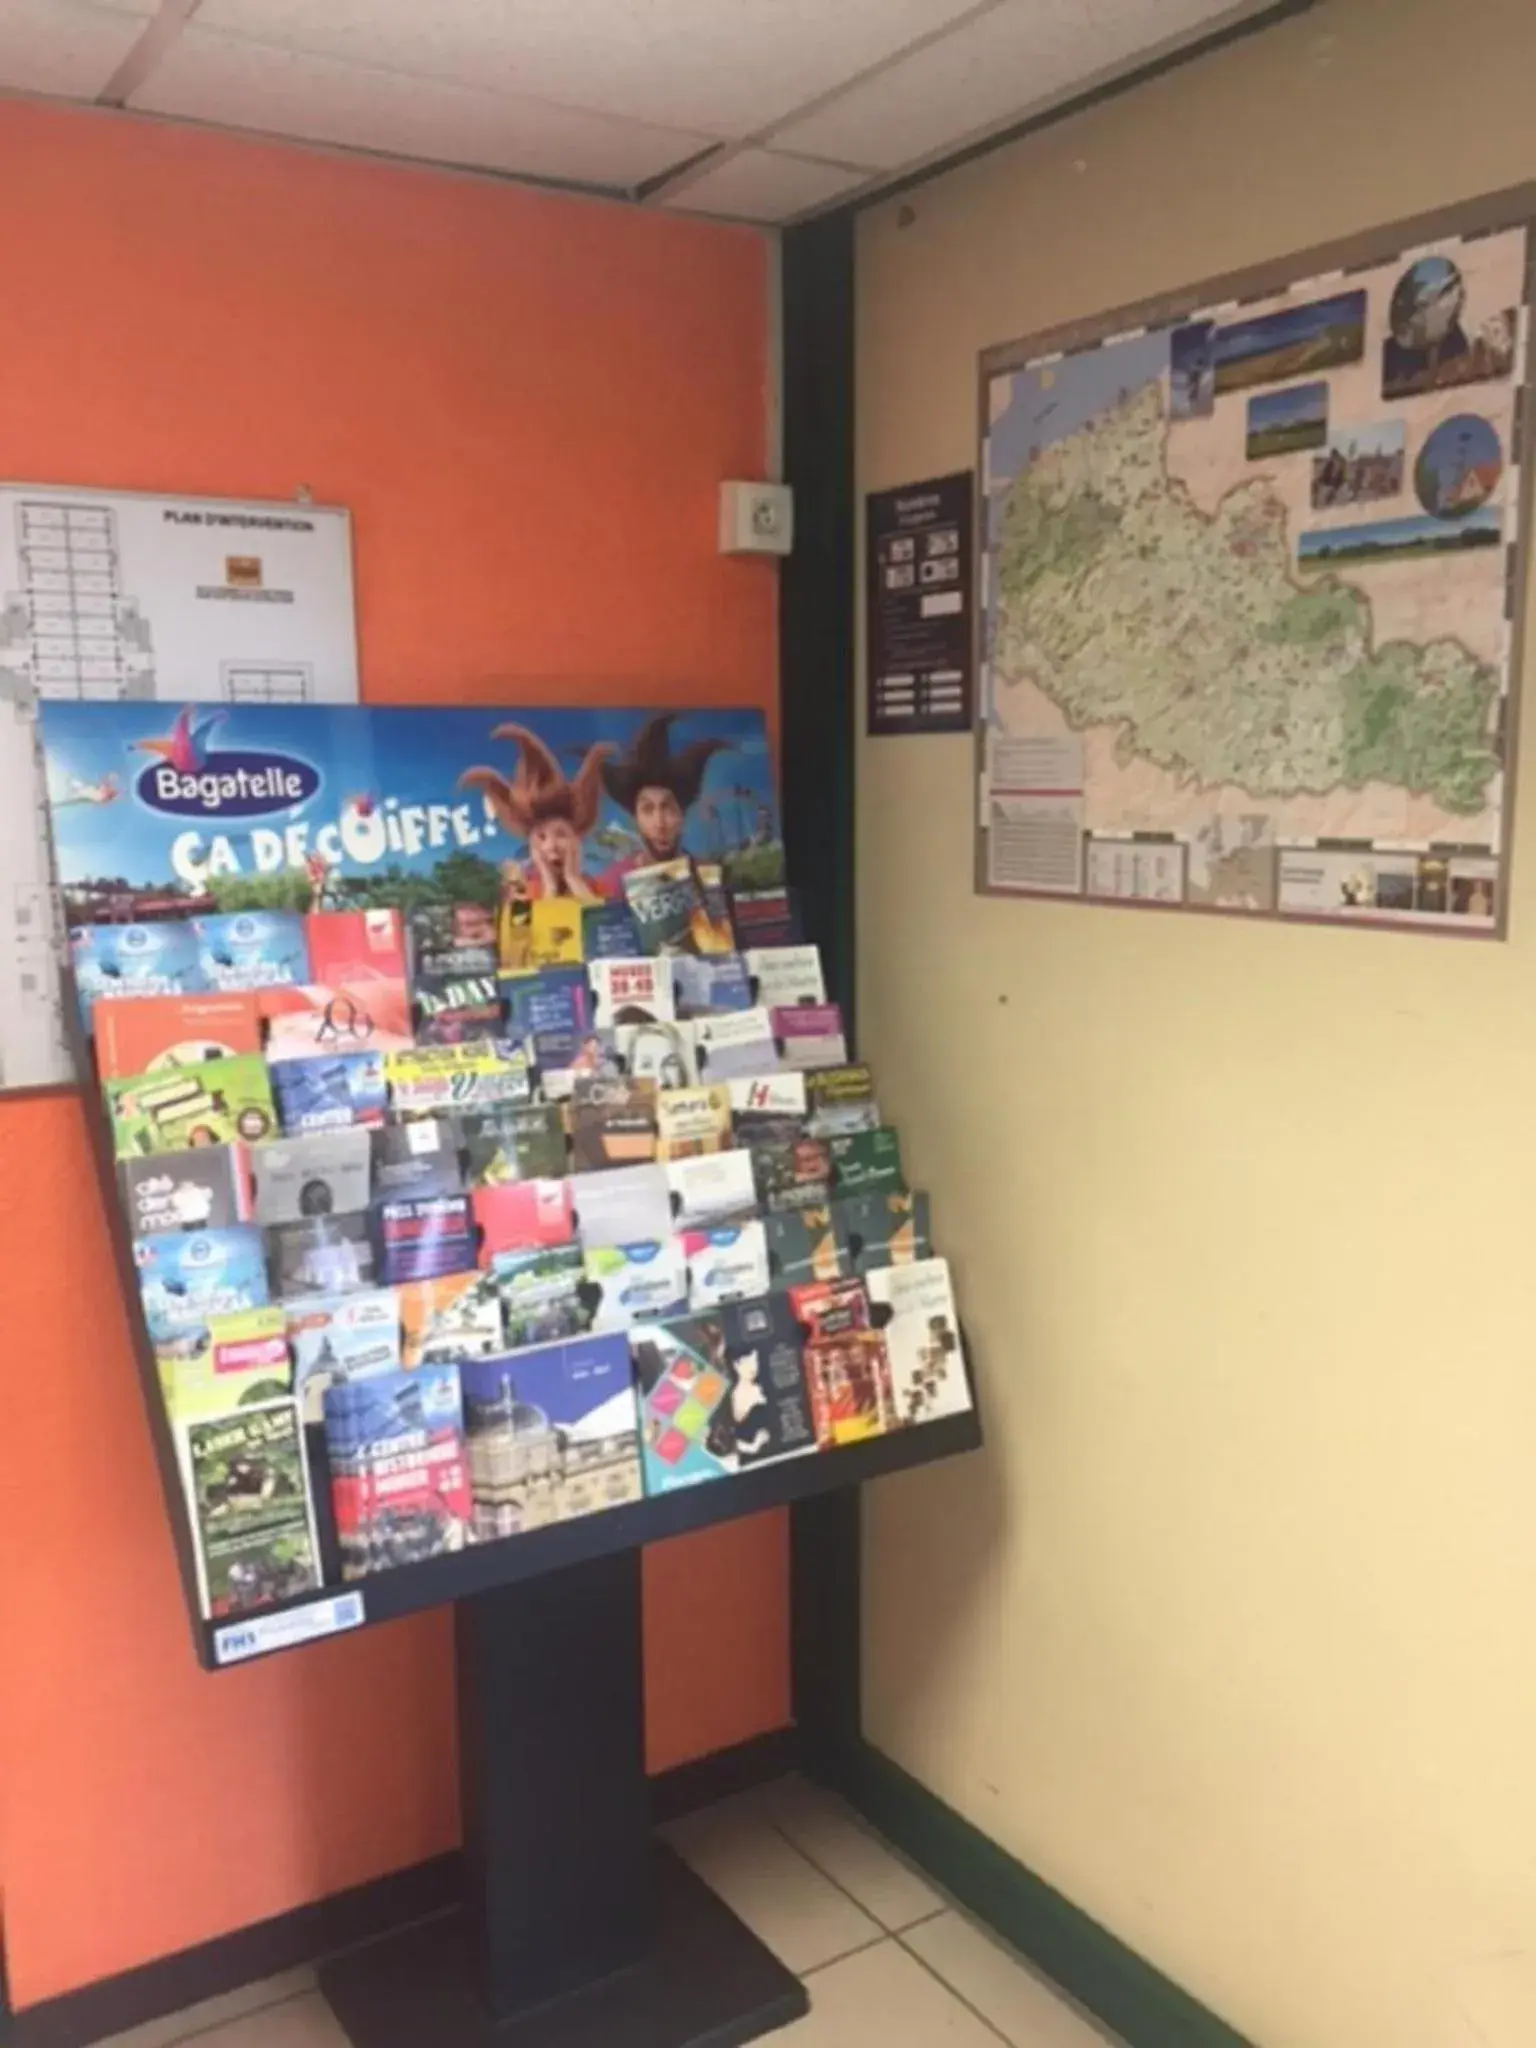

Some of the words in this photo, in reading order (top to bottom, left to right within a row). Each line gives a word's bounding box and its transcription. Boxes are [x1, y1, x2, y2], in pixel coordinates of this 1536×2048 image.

[164, 510, 202, 525] PLAN
[206, 512, 314, 532] D'INTERVENTION
[156, 768, 303, 808] Bagatelle
[171, 830, 240, 898] ÇA
